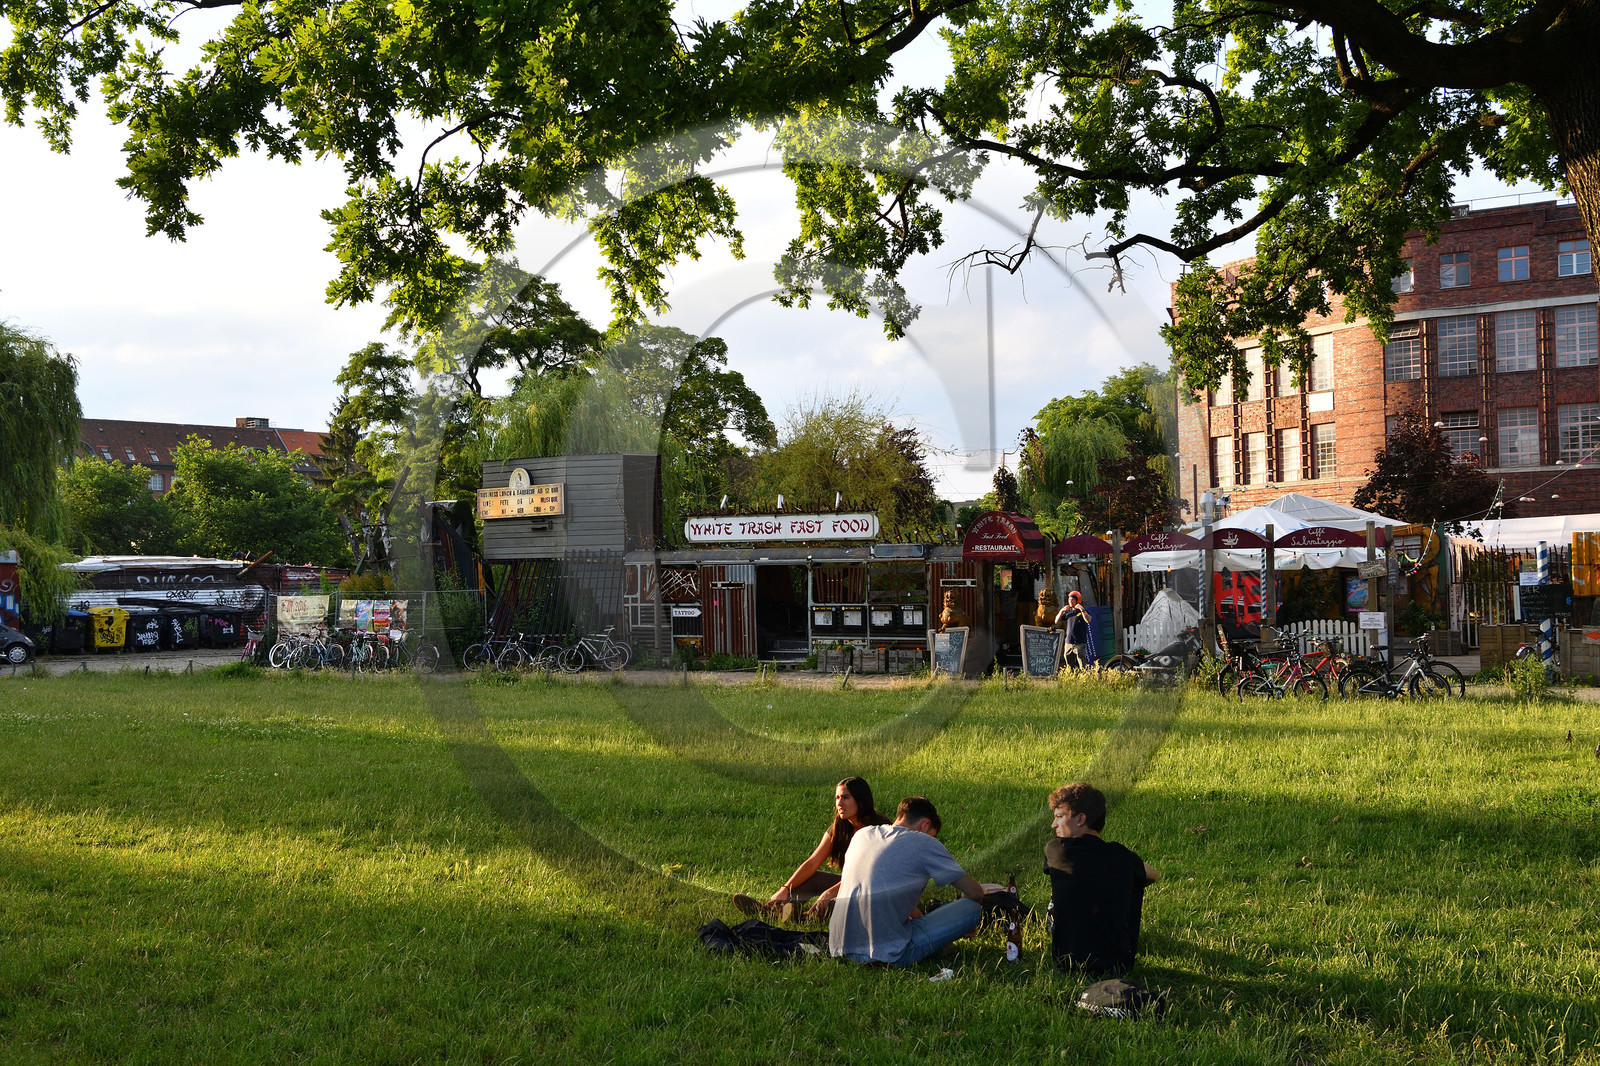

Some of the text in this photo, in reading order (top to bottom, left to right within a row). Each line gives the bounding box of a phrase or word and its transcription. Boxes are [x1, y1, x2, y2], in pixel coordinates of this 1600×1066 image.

[690, 518, 870, 536] WHITE TRASH FAST FOOD
[972, 515, 1018, 534] WHITE TRASH
